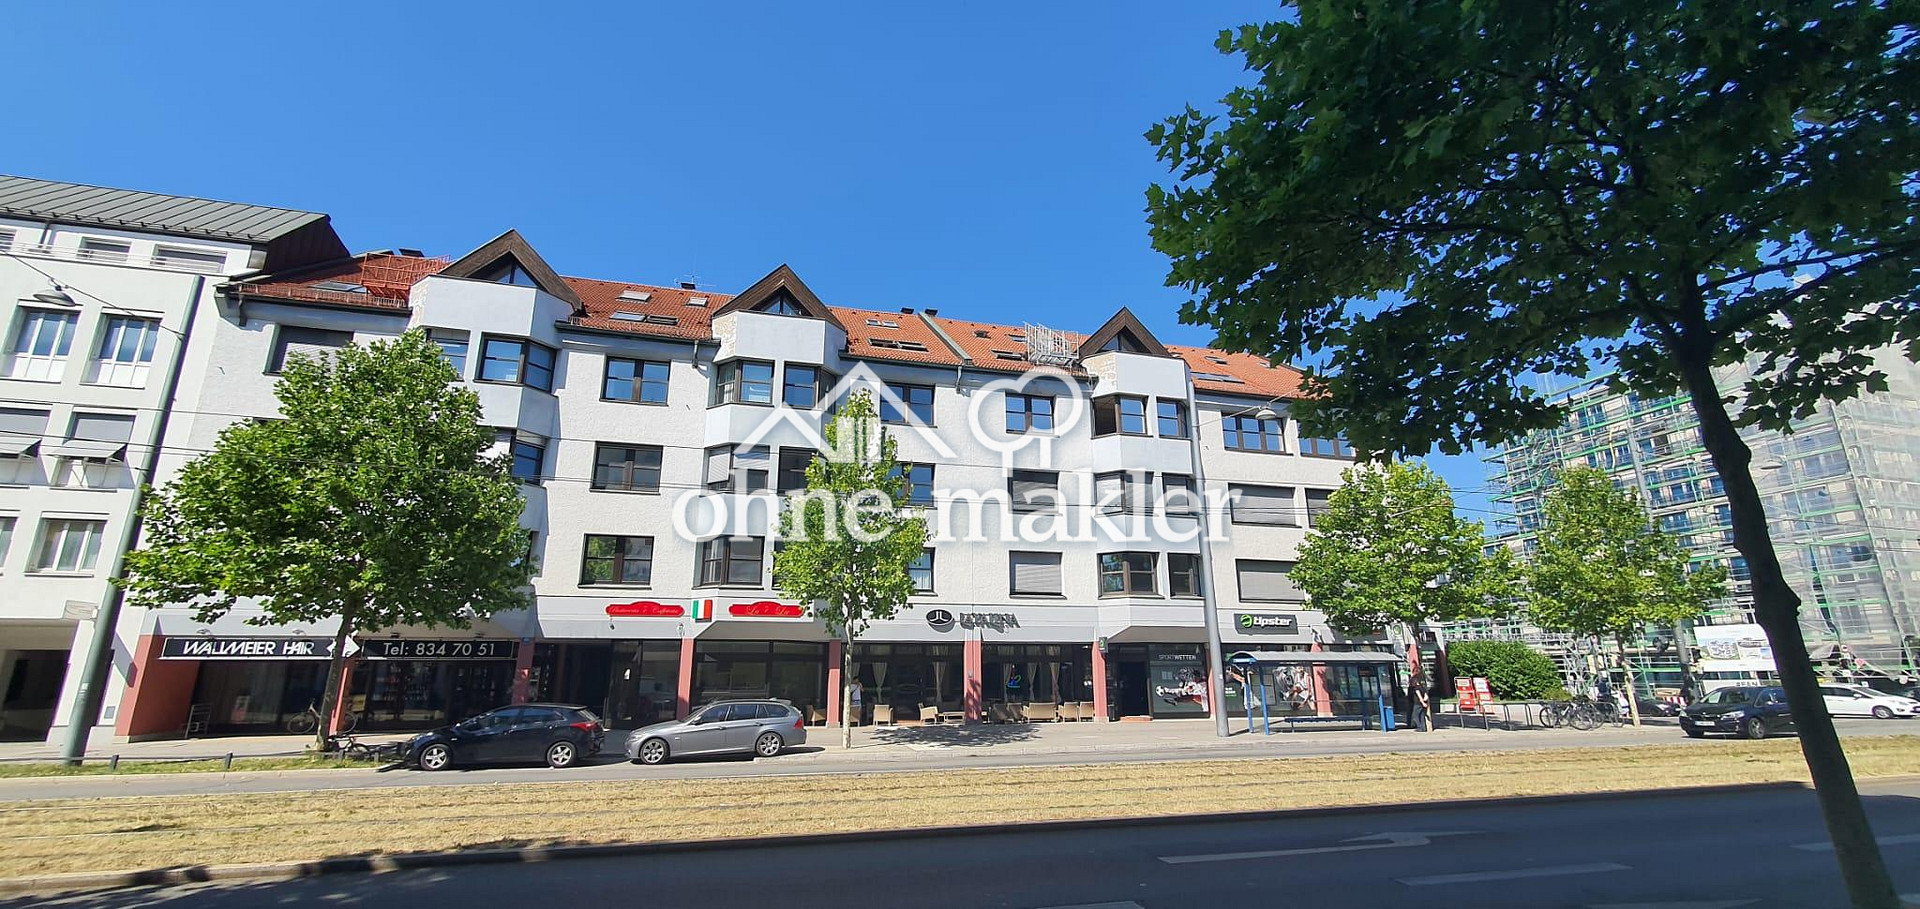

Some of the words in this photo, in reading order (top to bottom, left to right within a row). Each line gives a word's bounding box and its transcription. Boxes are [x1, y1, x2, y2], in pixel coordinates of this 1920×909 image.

[1253, 616, 1293, 628] tipster
[183, 640, 277, 655] WALLMEIER
[282, 641, 315, 655] HAIR
[383, 642, 410, 656] Tel:
[415, 642, 446, 656] 834
[452, 643, 472, 656] 70
[477, 643, 495, 656] 51
